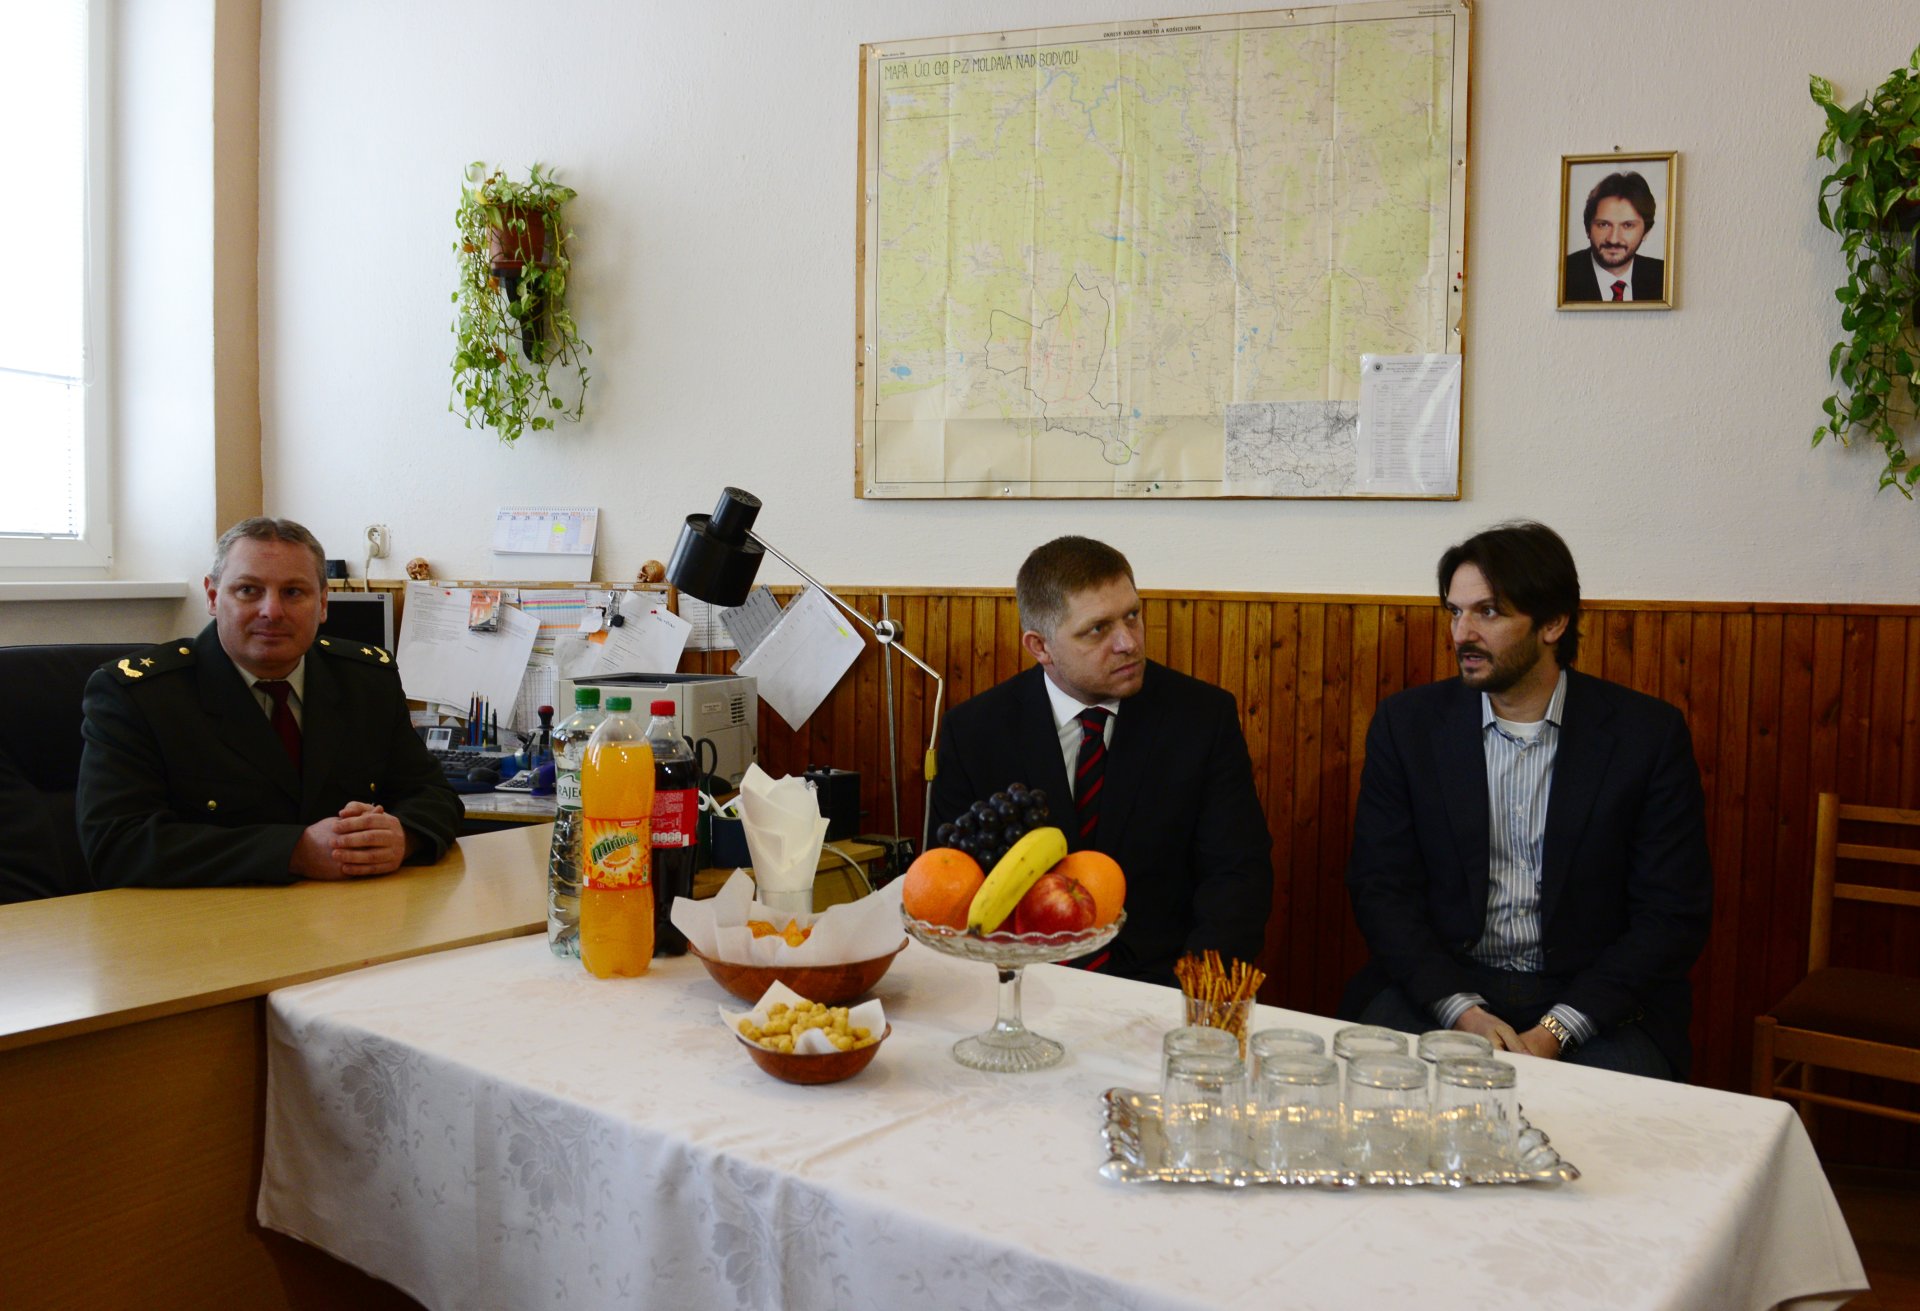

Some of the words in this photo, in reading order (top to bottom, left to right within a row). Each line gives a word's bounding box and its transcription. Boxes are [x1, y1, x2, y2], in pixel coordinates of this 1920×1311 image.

[884, 63, 908, 80] MAPA
[972, 55, 1012, 73] MOLDAVA
[1016, 54, 1036, 69] NAD
[1039, 50, 1078, 67] BODVOU
